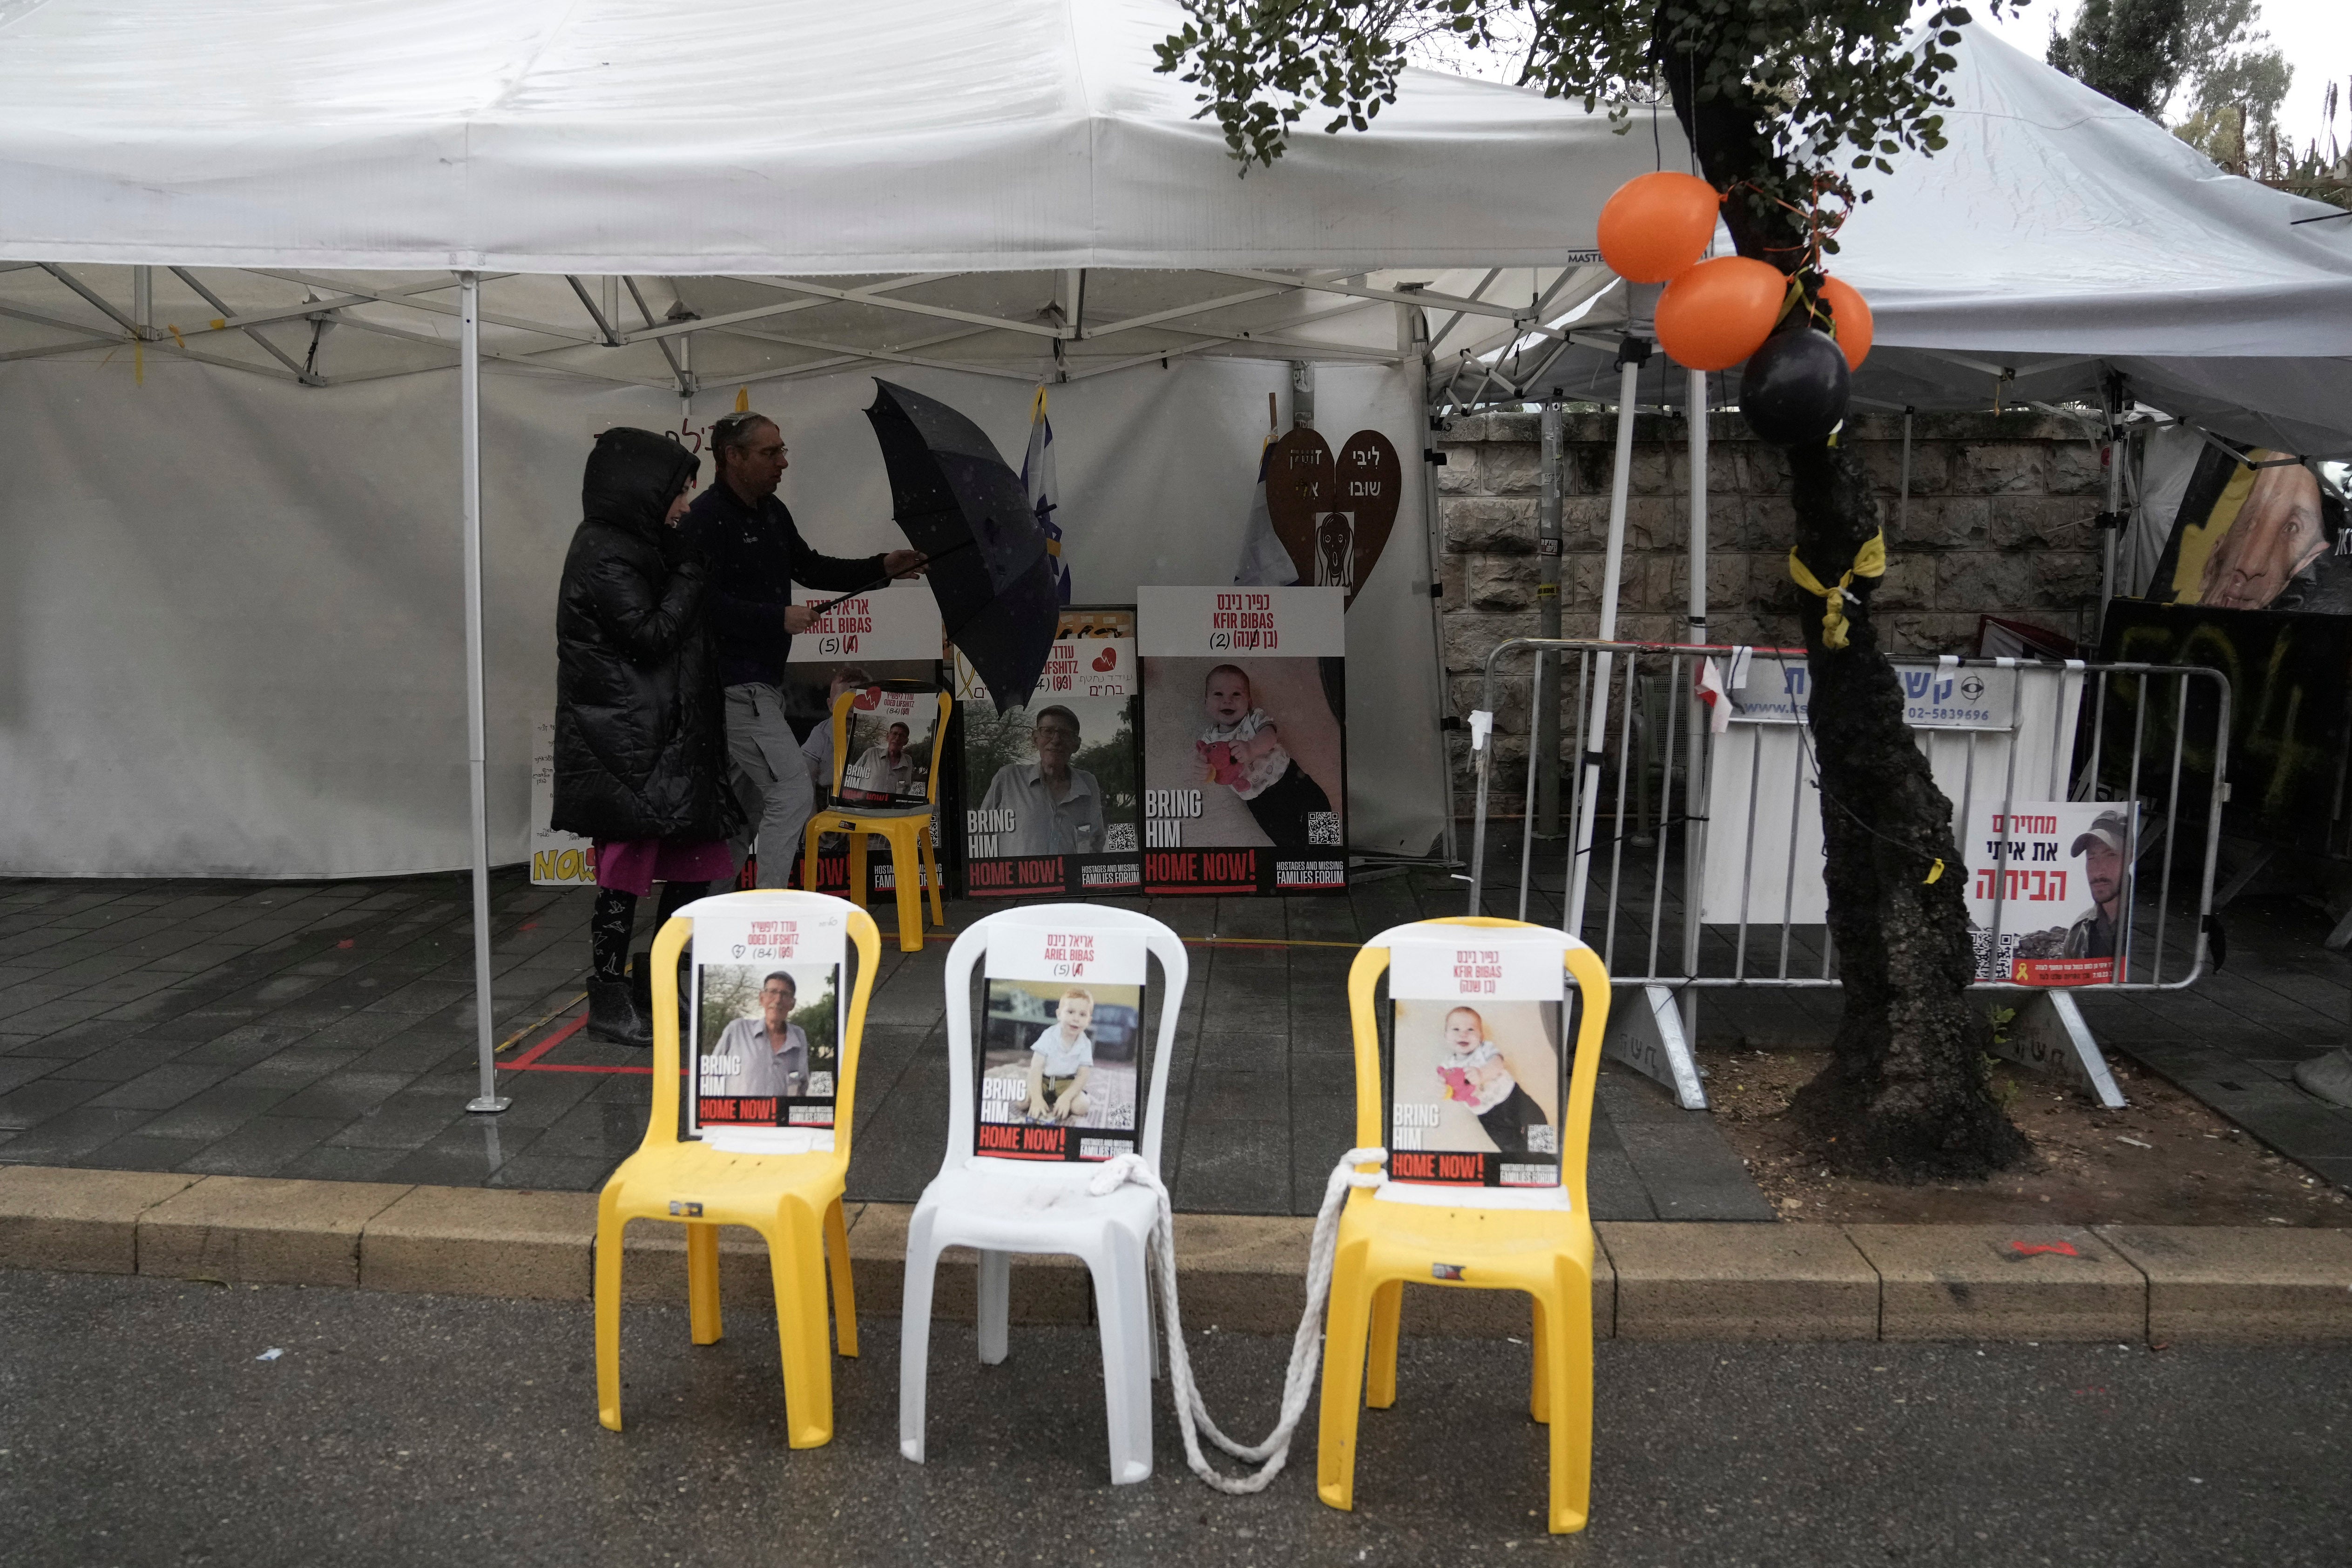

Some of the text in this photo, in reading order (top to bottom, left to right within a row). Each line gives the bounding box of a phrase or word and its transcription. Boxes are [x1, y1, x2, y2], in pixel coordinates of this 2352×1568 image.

[1568, 254, 1603, 262] MASTE
[1217, 594, 1270, 610] כפיר ביבס
[838, 617, 872, 633] BIBAS
[1213, 613, 1273, 629] KFIR BIBAS
[819, 637, 839, 655] (5)
[1210, 633, 1230, 649] (2)
[1053, 645, 1074, 659] עודד
[1745, 701, 1989, 721] www.ks 02-5839696
[846, 764, 871, 780] BRING
[844, 778, 860, 789] HIM
[1146, 790, 1202, 817] BRING
[967, 809, 1015, 832] BRING
[1993, 815, 2056, 834] מחזירם
[1146, 820, 1181, 847] HIM
[968, 835, 998, 858] HIM
[2033, 842, 2058, 861] את
[969, 856, 1064, 886] HOME NOW!
[1118, 864, 1139, 872] MISSING
[1145, 849, 1256, 881] HOME NOW!
[1277, 861, 1343, 871] HOSTAGES AND MISSING
[1082, 872, 1140, 885] FAMILIES FORUM
[1277, 870, 1344, 884] FAMILIES FORUM
[1976, 869, 2067, 901] הביתה
[769, 933, 799, 945] LIFSHITZ
[1048, 934, 1094, 947] אריאל ביבס
[753, 948, 777, 959] (84)
[1044, 948, 1094, 961] ARIEL BIBAS
[1457, 951, 1499, 963] כפיר ביבס
[1054, 964, 1070, 977] (5)
[1453, 966, 1502, 978] KFIR BIBAS
[700, 1055, 741, 1075] BRING
[700, 1076, 726, 1096] HIM
[982, 1077, 1027, 1102] BRING
[700, 1097, 776, 1119] HOME NOW!
[980, 1101, 1009, 1123] HIM
[1393, 1103, 1440, 1127] BRING
[980, 1126, 1020, 1149] HOME
[1024, 1127, 1065, 1152] NOW!
[1393, 1128, 1422, 1150] HIM
[1392, 1154, 1484, 1178] HOME NOW!
